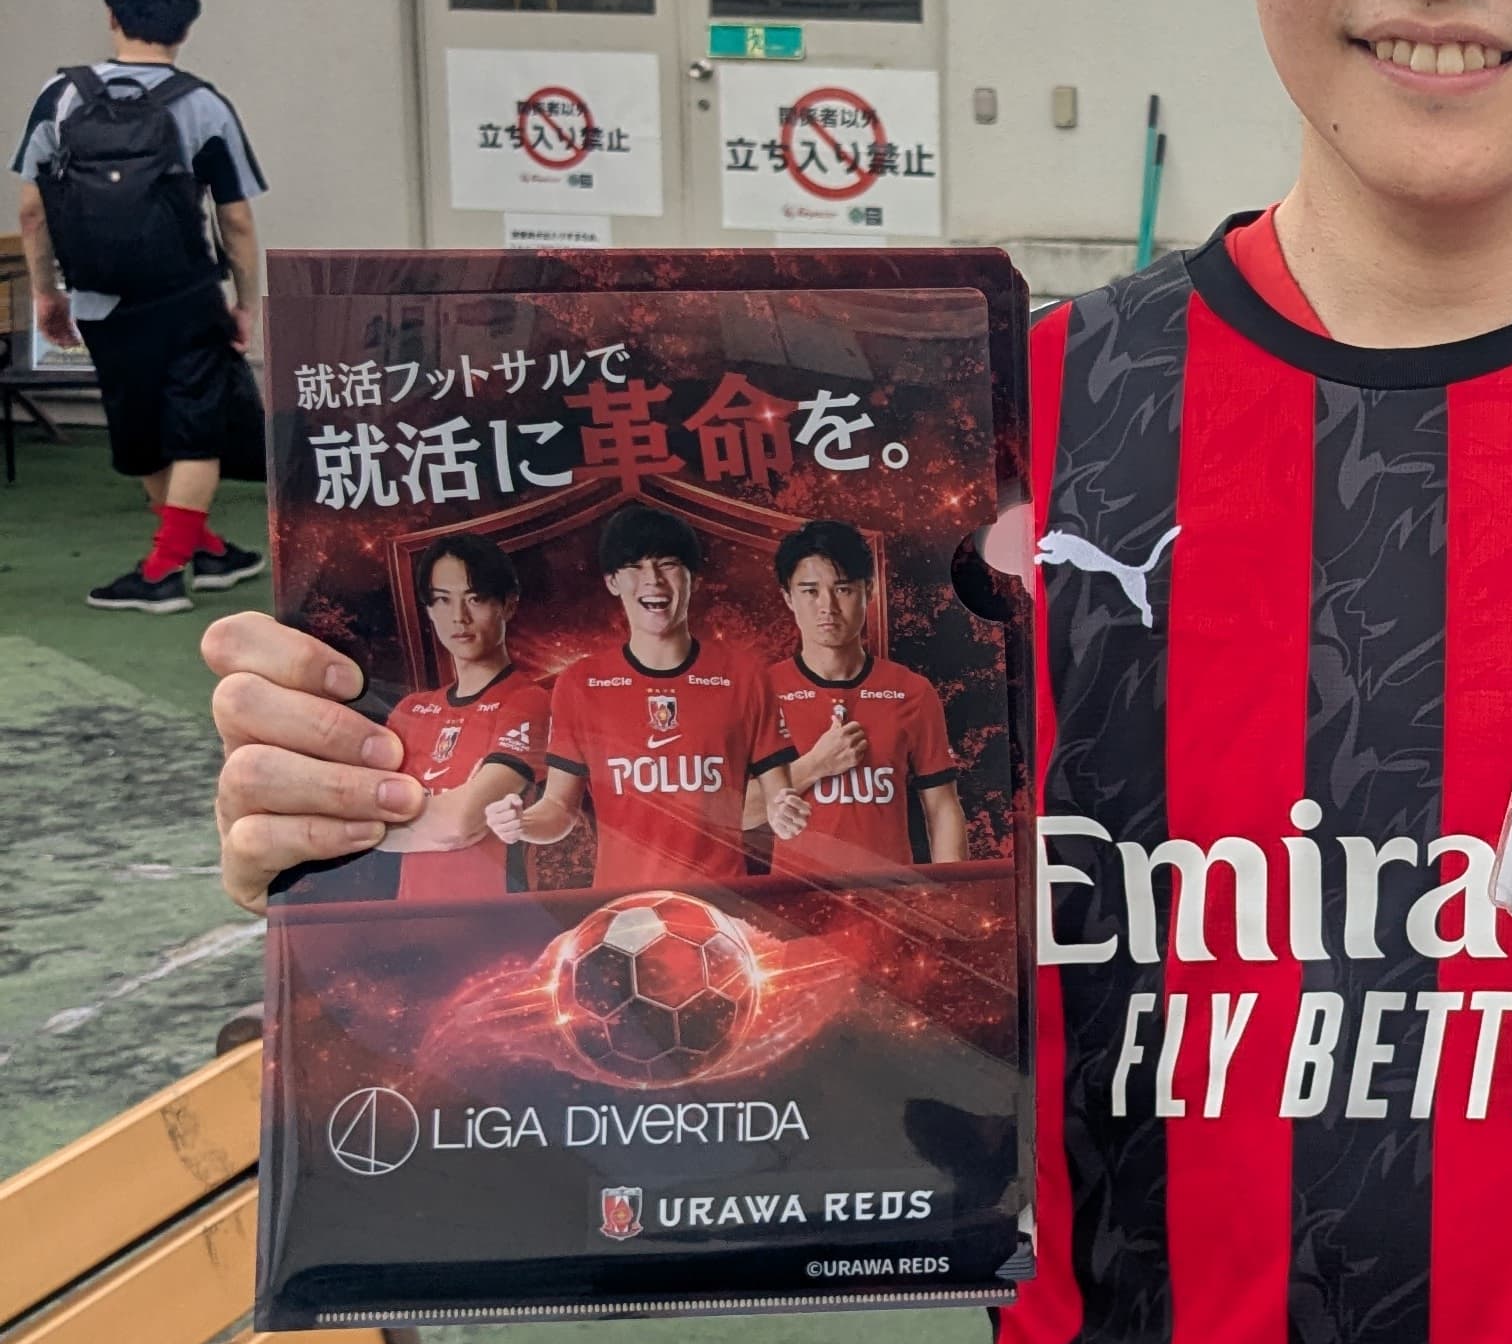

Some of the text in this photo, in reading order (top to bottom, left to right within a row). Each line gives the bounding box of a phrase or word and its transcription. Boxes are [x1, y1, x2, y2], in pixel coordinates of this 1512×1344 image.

[478, 122, 630, 153] 立ち入り禁止
[725, 138, 935, 178] 立ち入り禁止
[295, 343, 631, 411] 就活フットサルで
[307, 372, 910, 510] 就活に革命を。
[607, 755, 724, 795] POLUS
[813, 767, 895, 804] OLUS
[1111, 992, 1258, 1120] FLY
[658, 1190, 934, 1227] URAWA REDS
[899, 1256, 950, 1274] REDS
